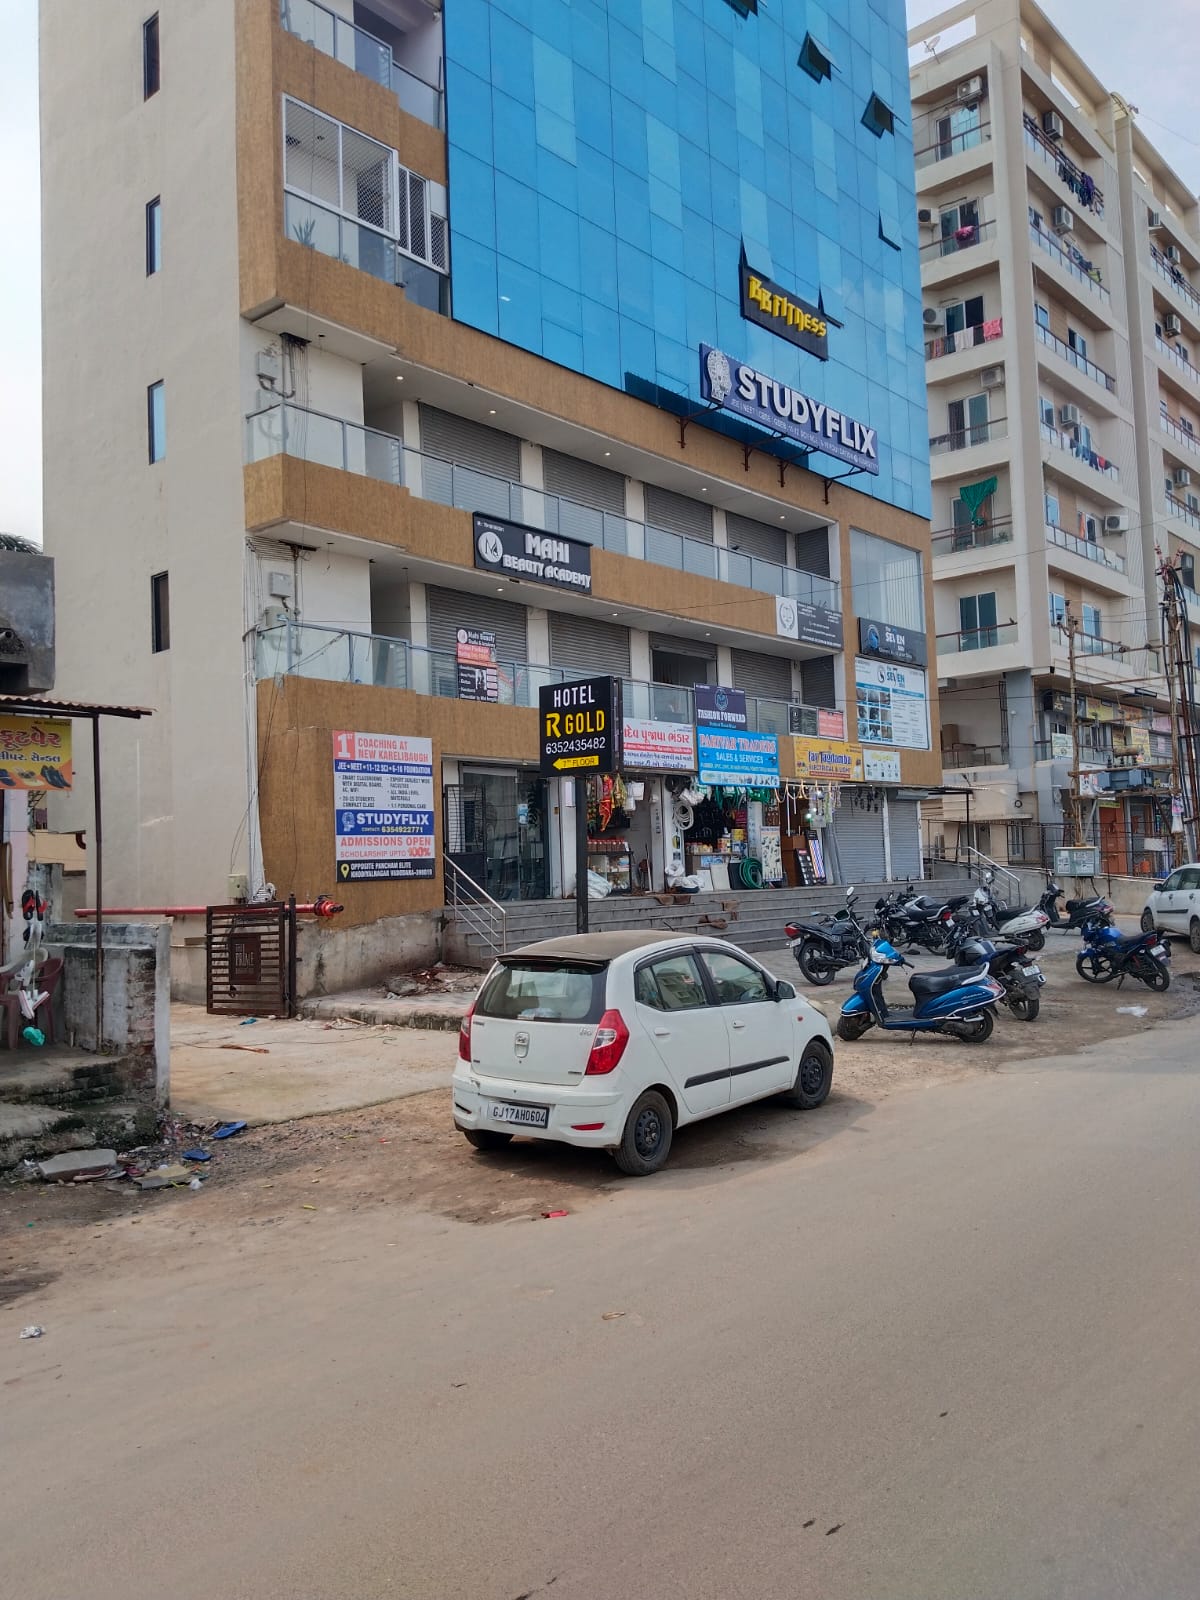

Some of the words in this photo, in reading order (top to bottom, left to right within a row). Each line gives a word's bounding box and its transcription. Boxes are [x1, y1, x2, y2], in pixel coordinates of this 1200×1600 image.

[738, 365, 876, 458] STUDYFLIX
[525, 533, 569, 564] MAHI
[502, 554, 544, 576] BEAUTY
[545, 565, 591, 588] ACADEMY
[554, 685, 595, 708] HOTEL
[697, 709, 720, 721] FASHION
[720, 711, 746, 723] FORWARD
[546, 712, 561, 738] R
[565, 710, 605, 735] GOLD
[358, 737, 397, 750] COACHING
[400, 741, 408, 750] AT
[545, 737, 606, 754] 6352435482
[738, 737, 777, 755] TRADERS
[358, 749, 376, 760] NEW
[379, 751, 429, 763] KARELIBAUGH
[573, 758, 595, 767] FLOOR
[716, 752, 733, 762] SALES
[734, 754, 739, 762] &
[739, 754, 764, 764] SERVICES
[338, 762, 347, 770] JEE
[350, 762, 362, 771] NEET
[366, 763, 380, 772] 11-12
[356, 812, 429, 825] STUDYFLIX
[341, 836, 403, 847] ADMISSIONS
[406, 837, 431, 846] OPEN
[341, 850, 388, 858] SCHOLARSHIP
[407, 847, 431, 857] 100%
[493, 1106, 546, 1123] GJ17AH0604
